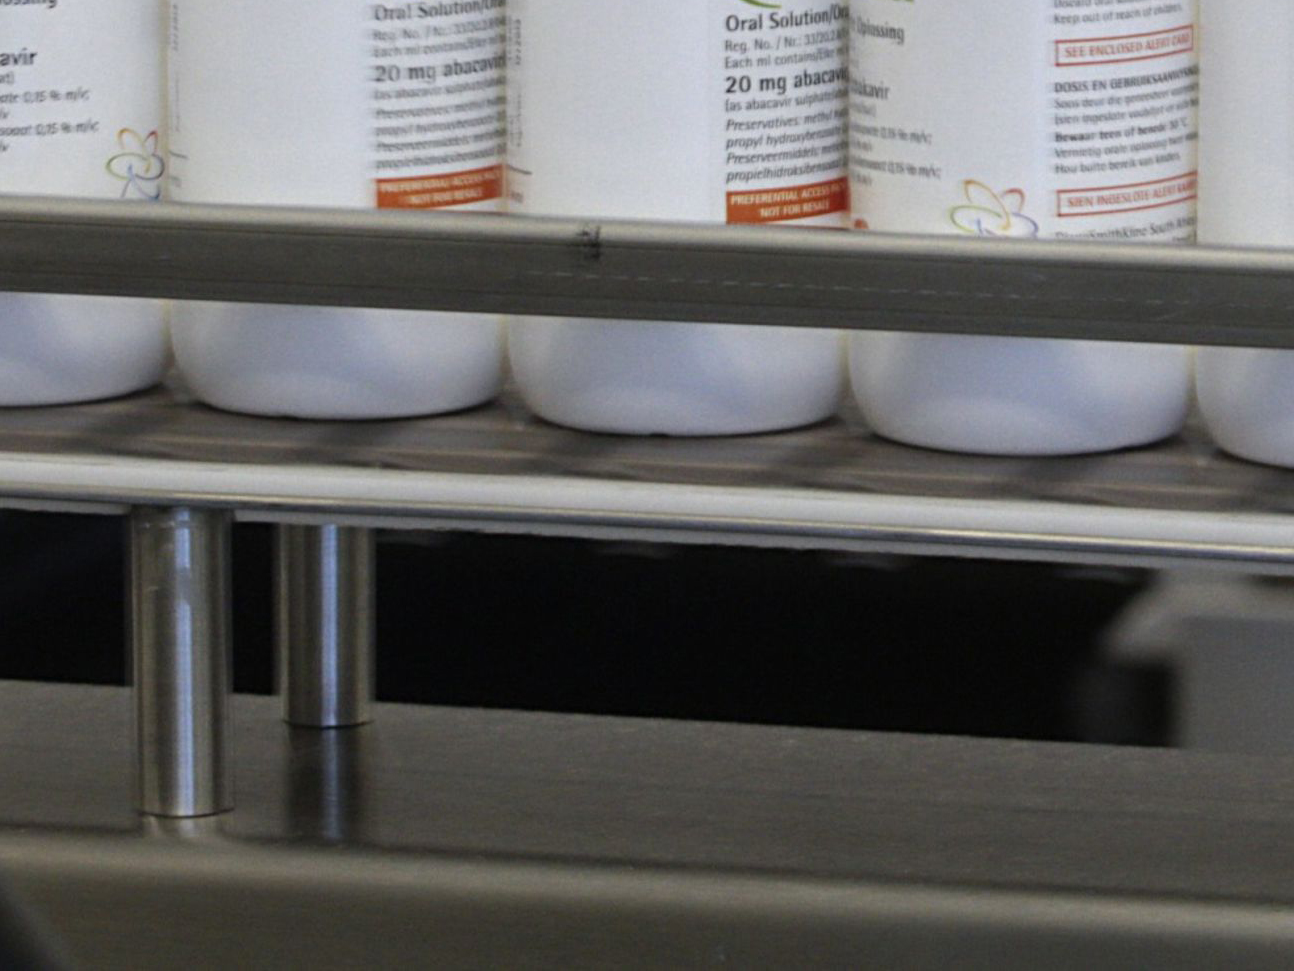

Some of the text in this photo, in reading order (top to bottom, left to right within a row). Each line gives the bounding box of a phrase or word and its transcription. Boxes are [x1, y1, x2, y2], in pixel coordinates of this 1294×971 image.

[725, 13, 763, 32] Oral
[1064, 45, 1087, 58] SEE
[1089, 41, 1144, 57] ENCLOSED
[724, 56, 752, 69] Each
[375, 65, 400, 83] 20
[408, 66, 437, 85] mg
[725, 75, 751, 94] 20
[759, 75, 787, 96] mg
[1092, 79, 1107, 91] EN
